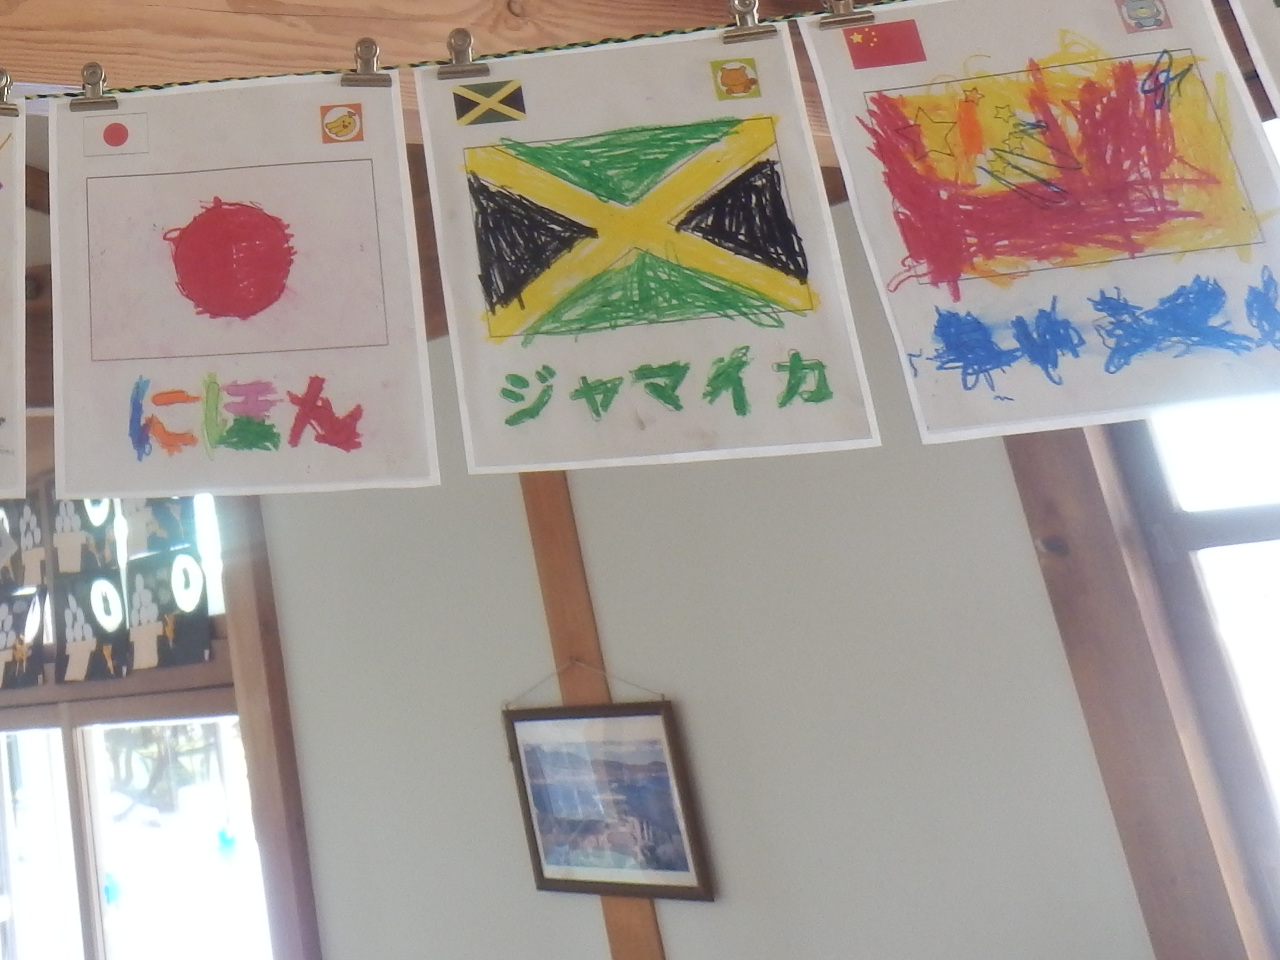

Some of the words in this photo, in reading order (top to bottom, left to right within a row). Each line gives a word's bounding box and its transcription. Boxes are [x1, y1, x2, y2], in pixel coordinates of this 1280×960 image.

[127, 371, 364, 462] にほん
[499, 344, 834, 427] ジャマイカ
